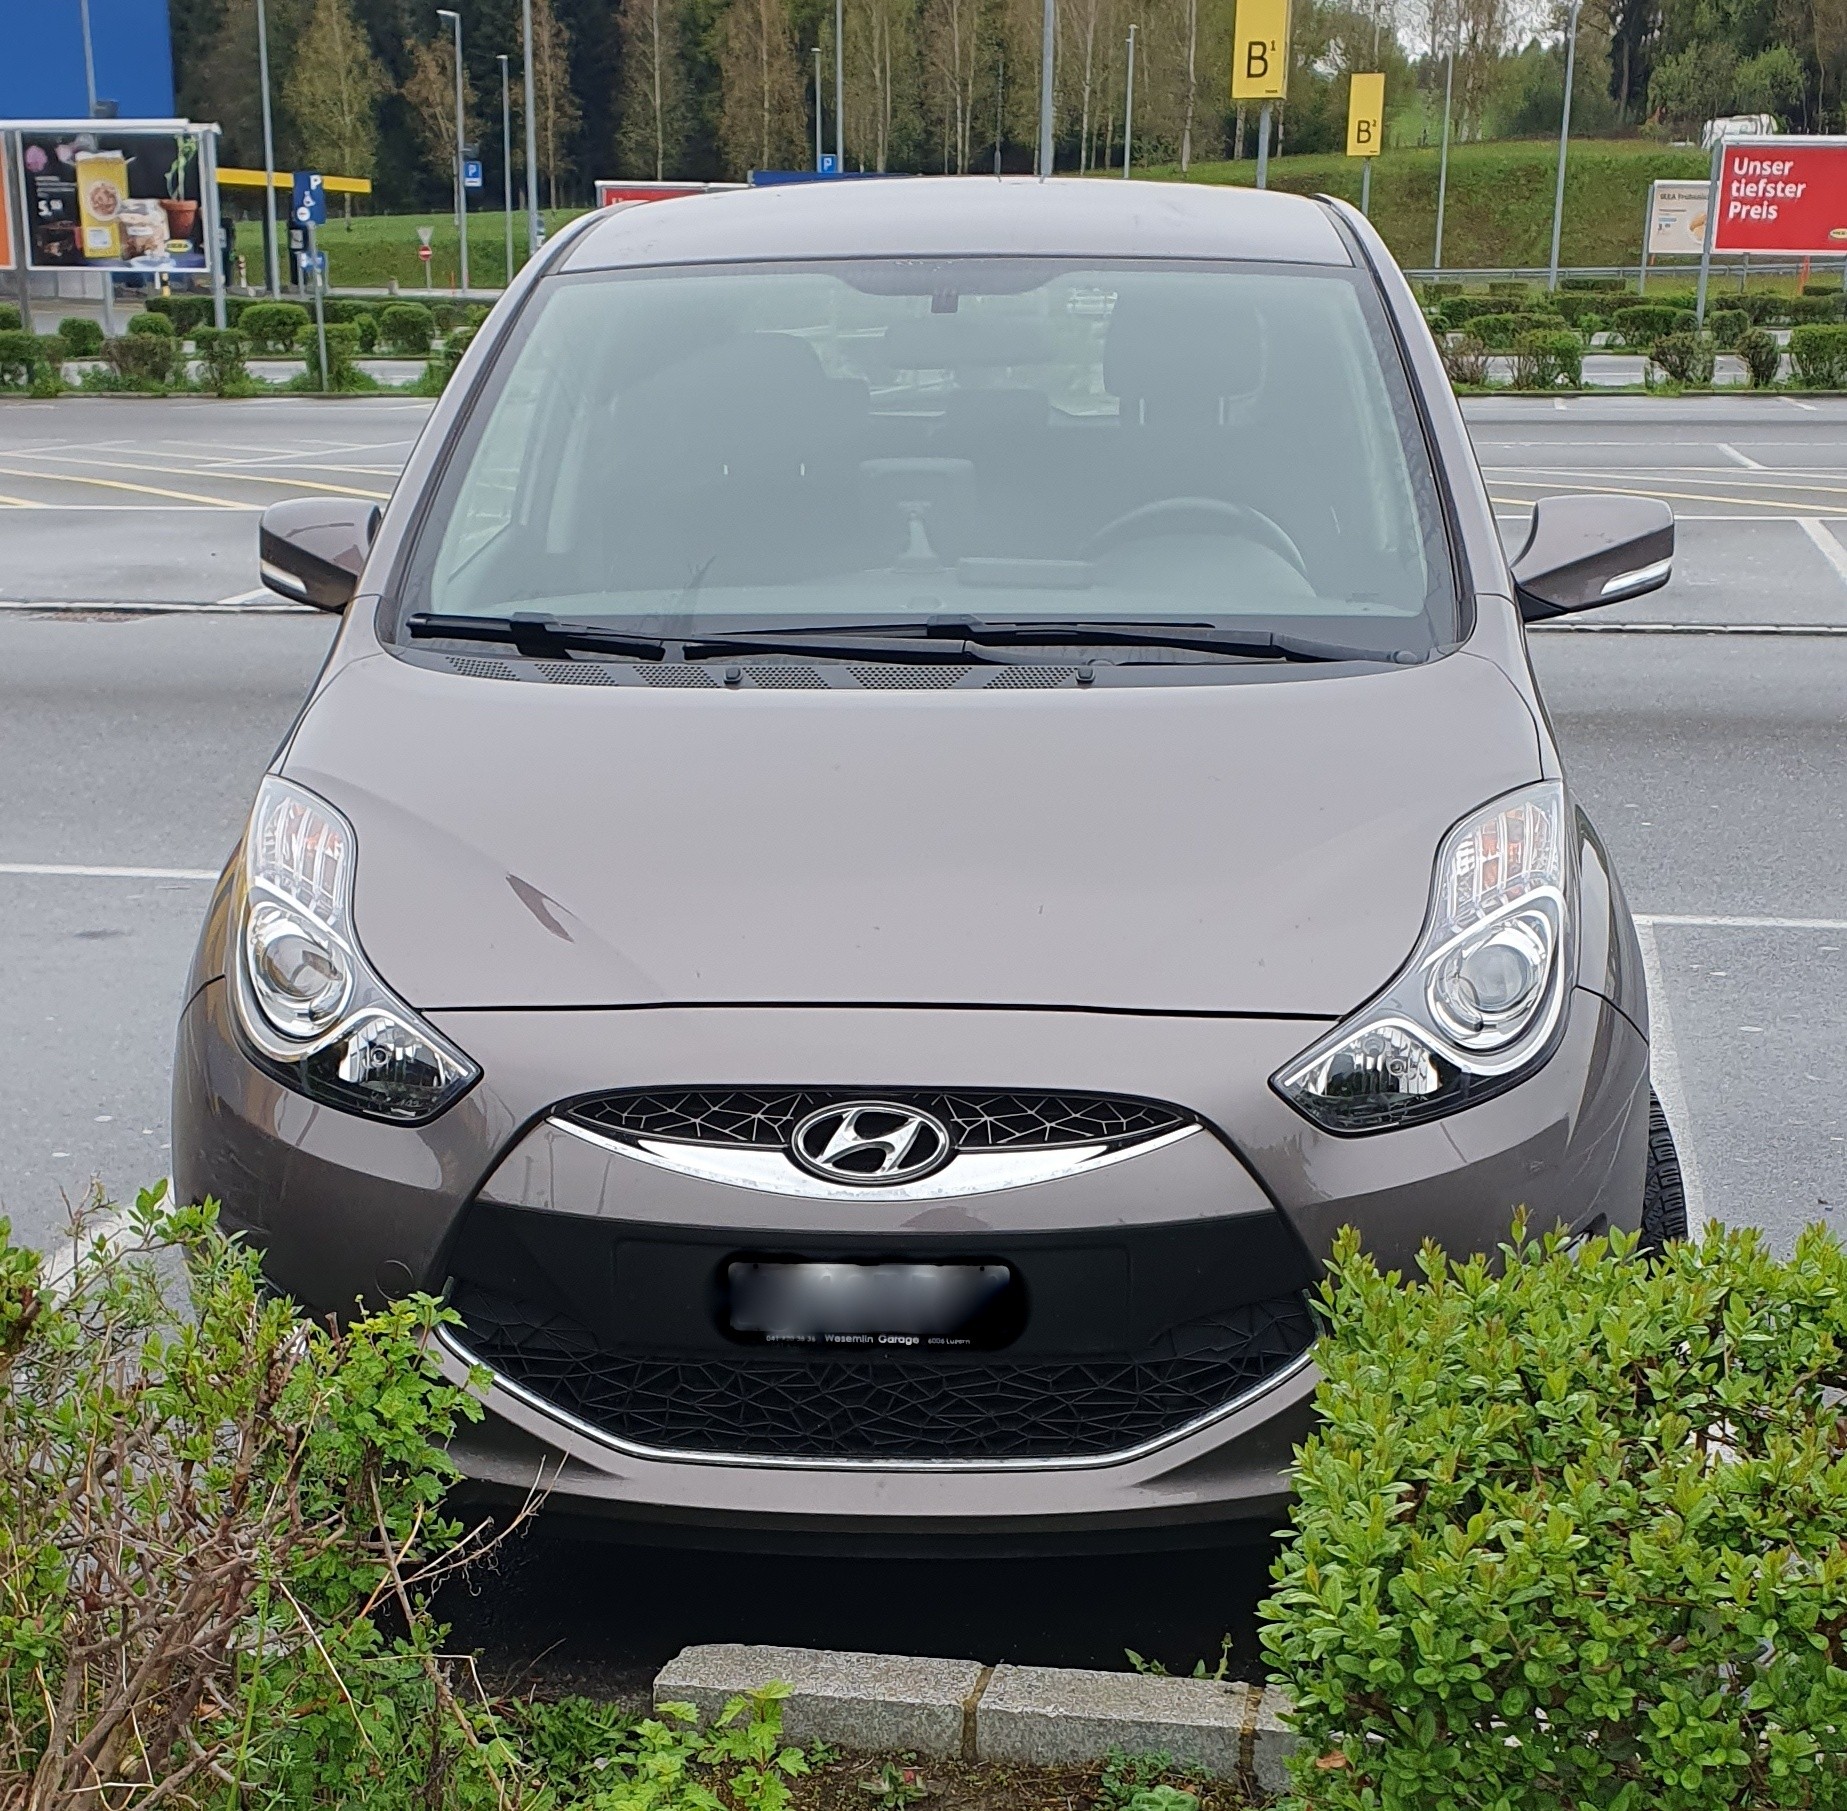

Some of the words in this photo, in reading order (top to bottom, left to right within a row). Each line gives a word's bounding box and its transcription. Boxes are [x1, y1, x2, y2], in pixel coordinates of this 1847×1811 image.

[468, 164, 477, 177] P
[1733, 156, 1794, 176] Unser
[309, 174, 322, 190] P
[1731, 178, 1807, 200] tiefster
[1728, 201, 1778, 220] Preis
[824, 1334, 874, 1343] Wesemlin
[878, 1335, 920, 1346] Garage
